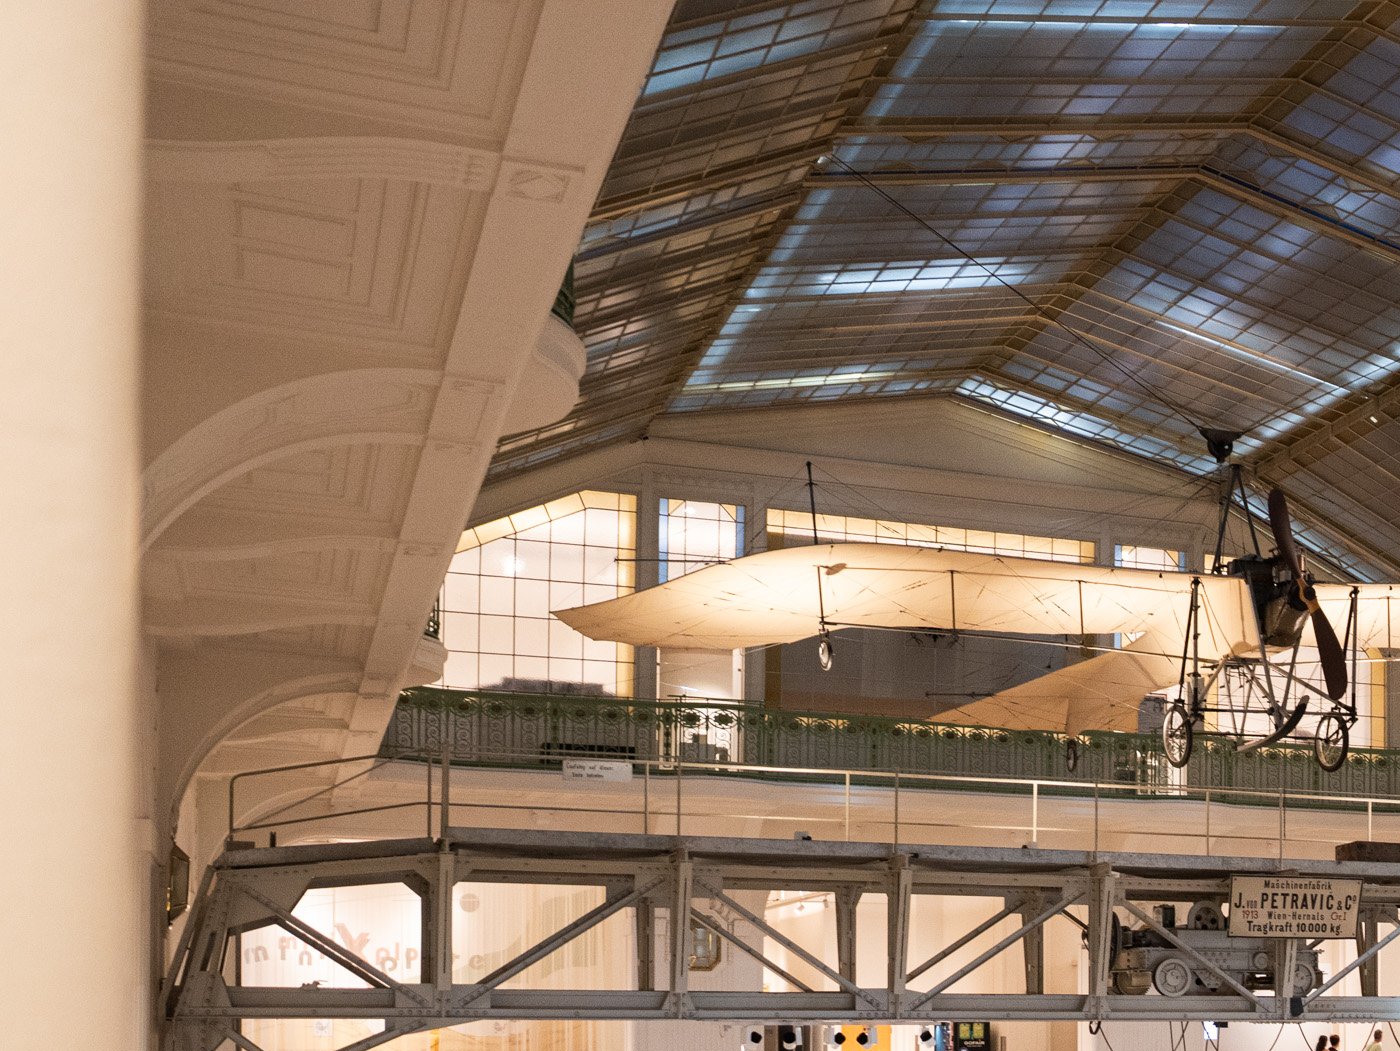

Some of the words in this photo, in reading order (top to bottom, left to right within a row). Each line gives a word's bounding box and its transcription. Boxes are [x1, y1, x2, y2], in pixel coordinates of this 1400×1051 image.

[1264, 879, 1332, 891] Maschinenfabrik
[1234, 893, 1245, 909] J.
[1336, 901, 1343, 910] &
[1242, 910, 1259, 919] 1913
[1267, 911, 1325, 921] Wien-Hernals
[1246, 920, 1293, 935] Tragkraft
